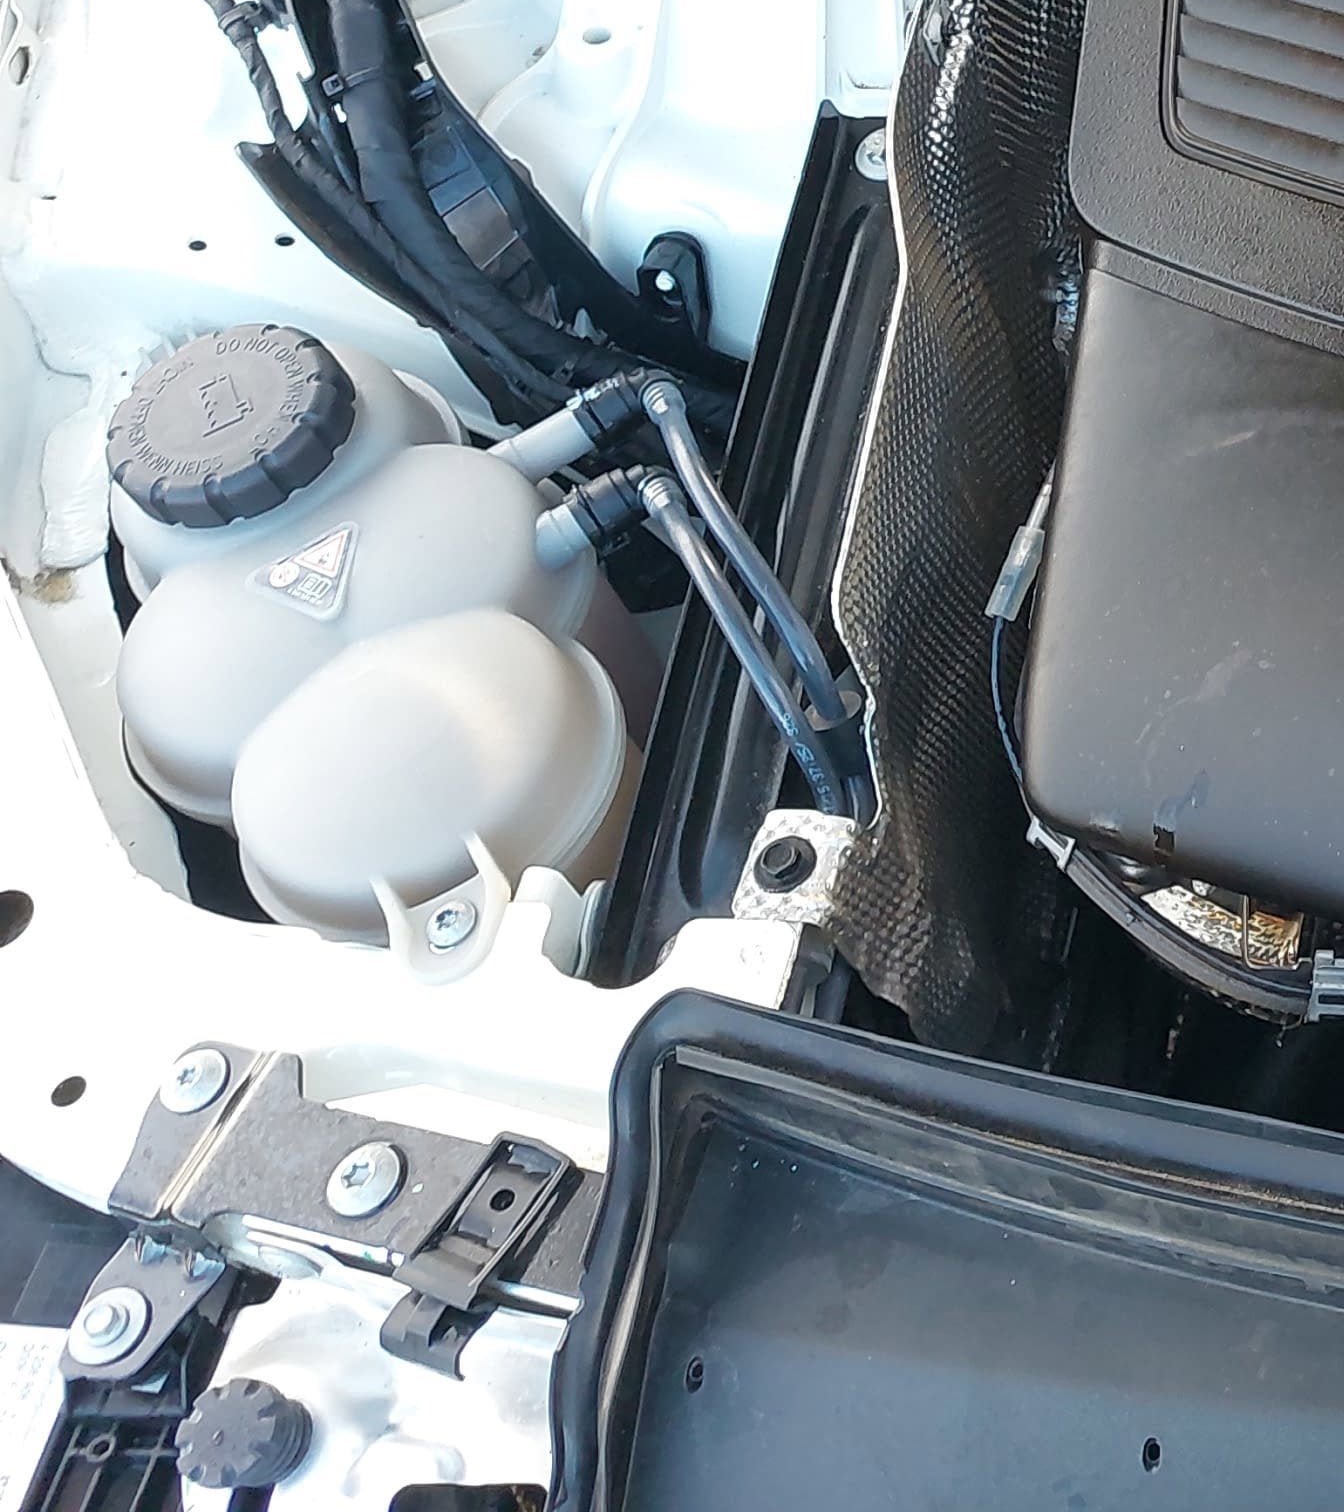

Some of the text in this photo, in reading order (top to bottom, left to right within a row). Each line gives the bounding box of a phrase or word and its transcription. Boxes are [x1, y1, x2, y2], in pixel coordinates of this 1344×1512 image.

[215, 338, 242, 356] DO
[243, 336, 279, 356] NOT
[274, 345, 305, 381] OPEN
